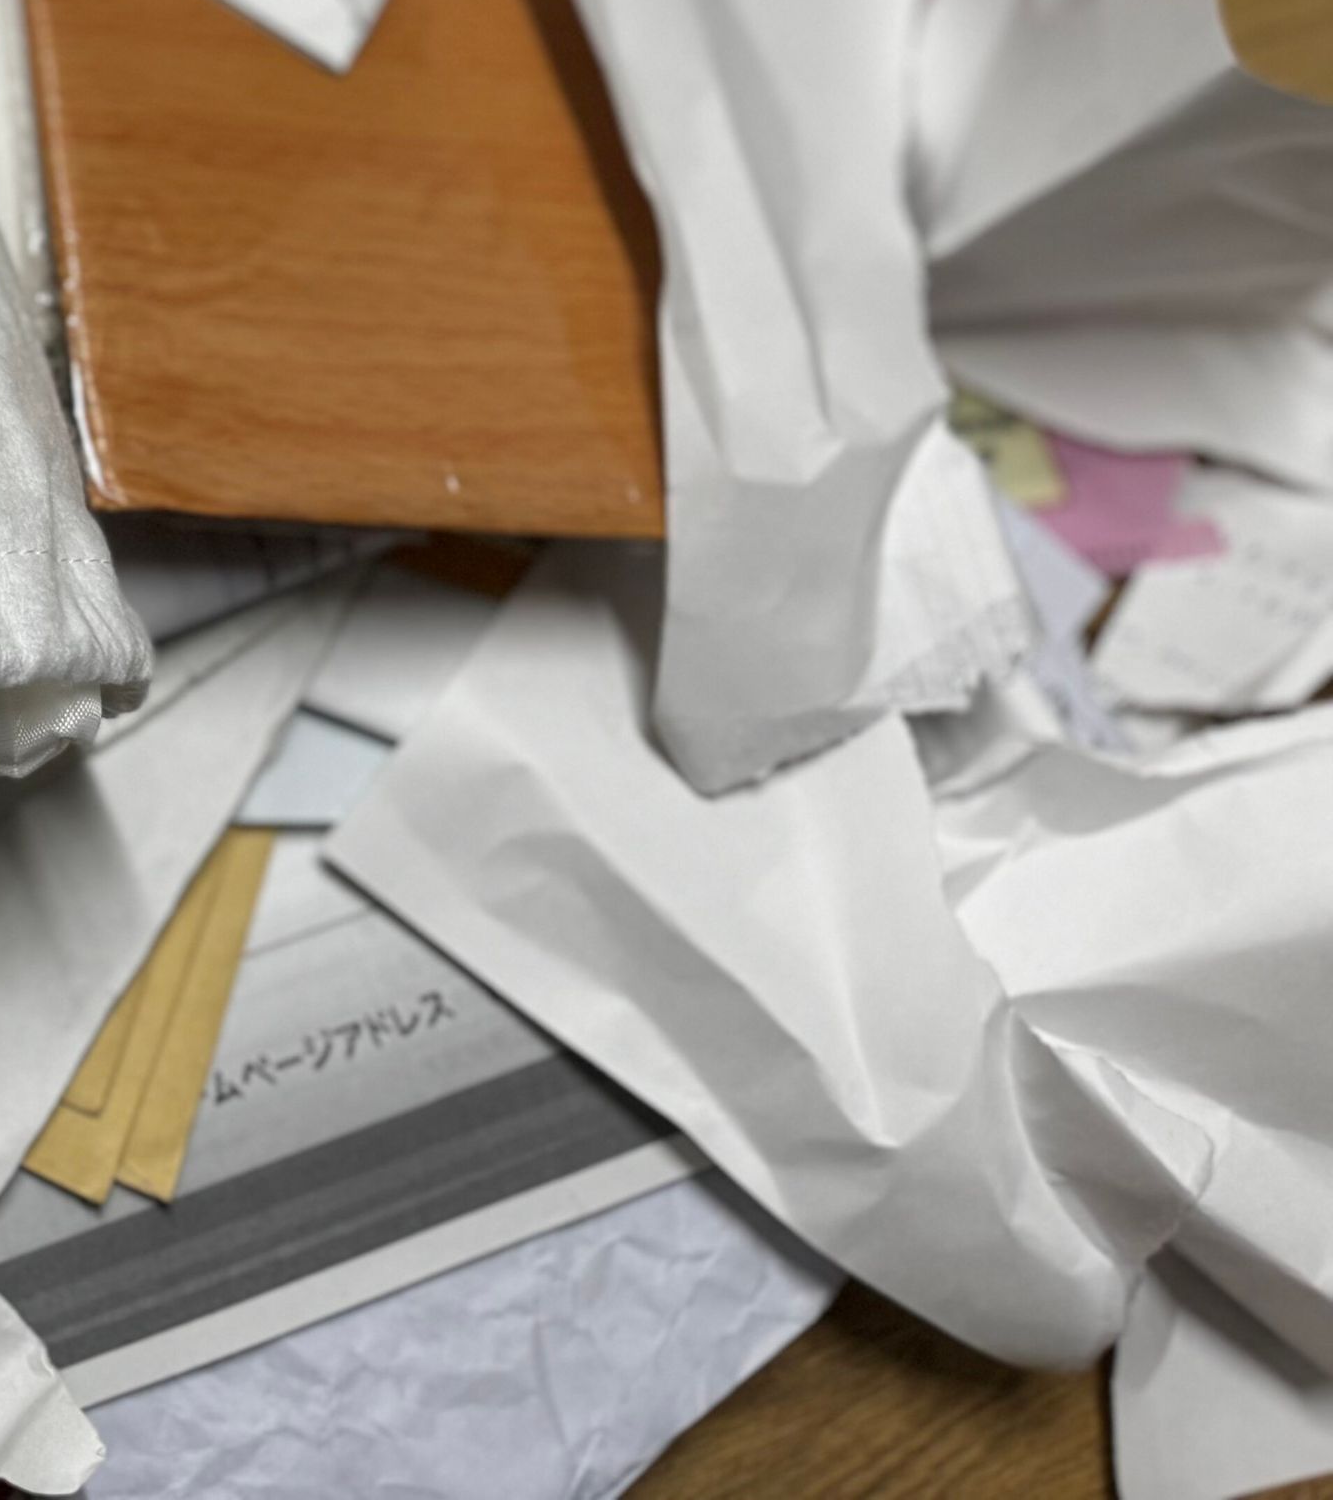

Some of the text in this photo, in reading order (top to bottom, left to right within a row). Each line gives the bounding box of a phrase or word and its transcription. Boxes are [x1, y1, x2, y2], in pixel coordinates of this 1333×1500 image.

[199, 991, 456, 1106] ムページアドレス
